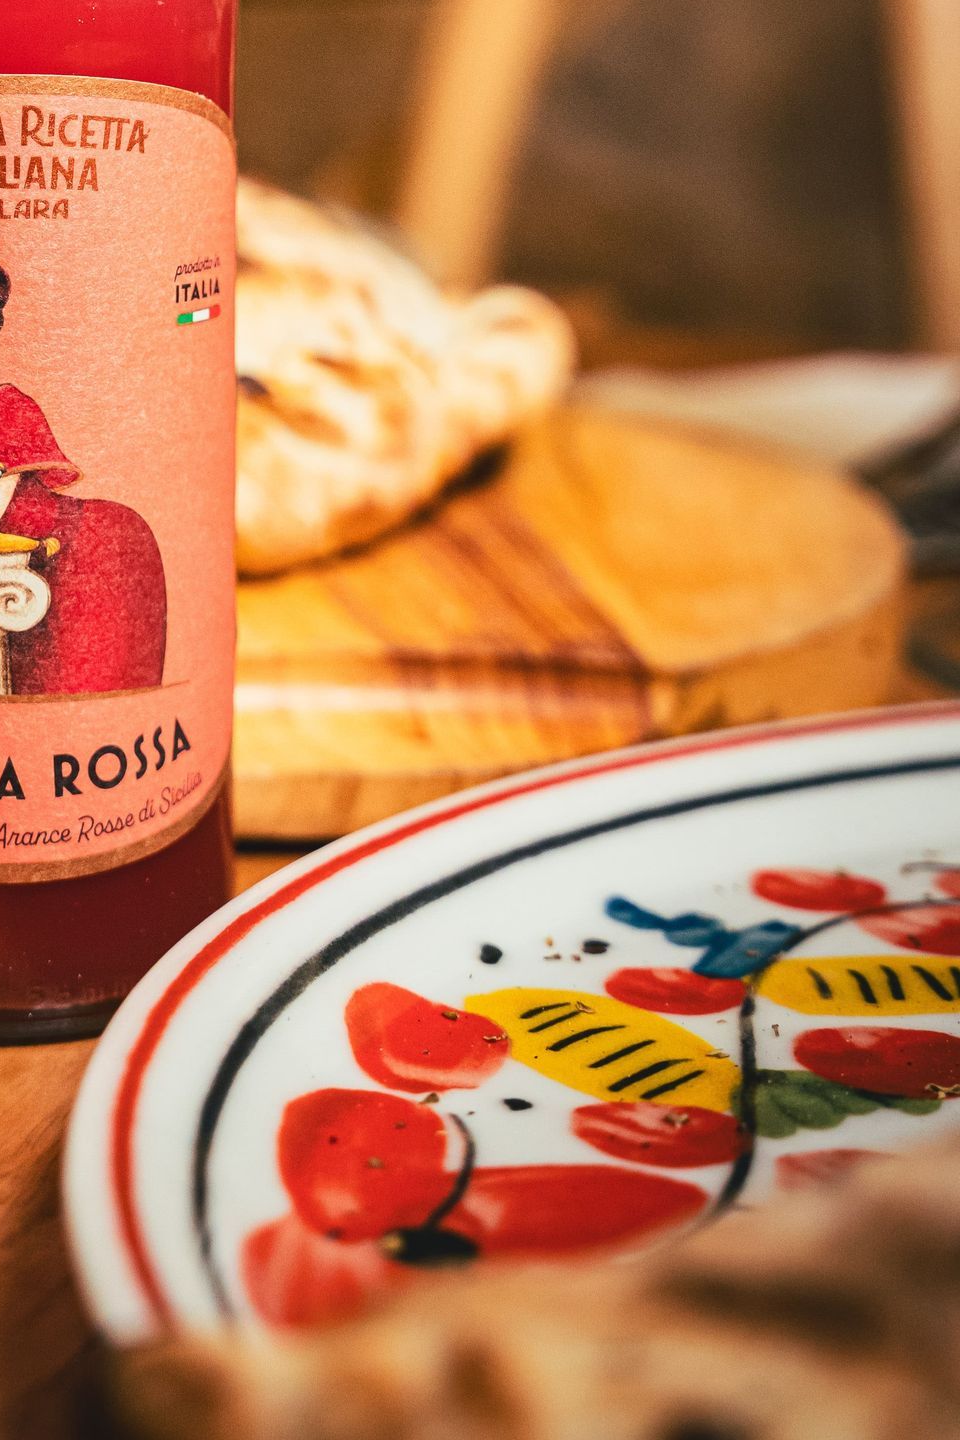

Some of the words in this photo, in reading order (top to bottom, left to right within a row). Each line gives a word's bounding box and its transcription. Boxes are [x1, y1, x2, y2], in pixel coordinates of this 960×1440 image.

[175, 278, 221, 304] ITALIA
[53, 717, 192, 798] ROSSA
[77, 814, 136, 843] Rosse
[138, 797, 156, 823] di
[159, 771, 203, 815] Sicilia
